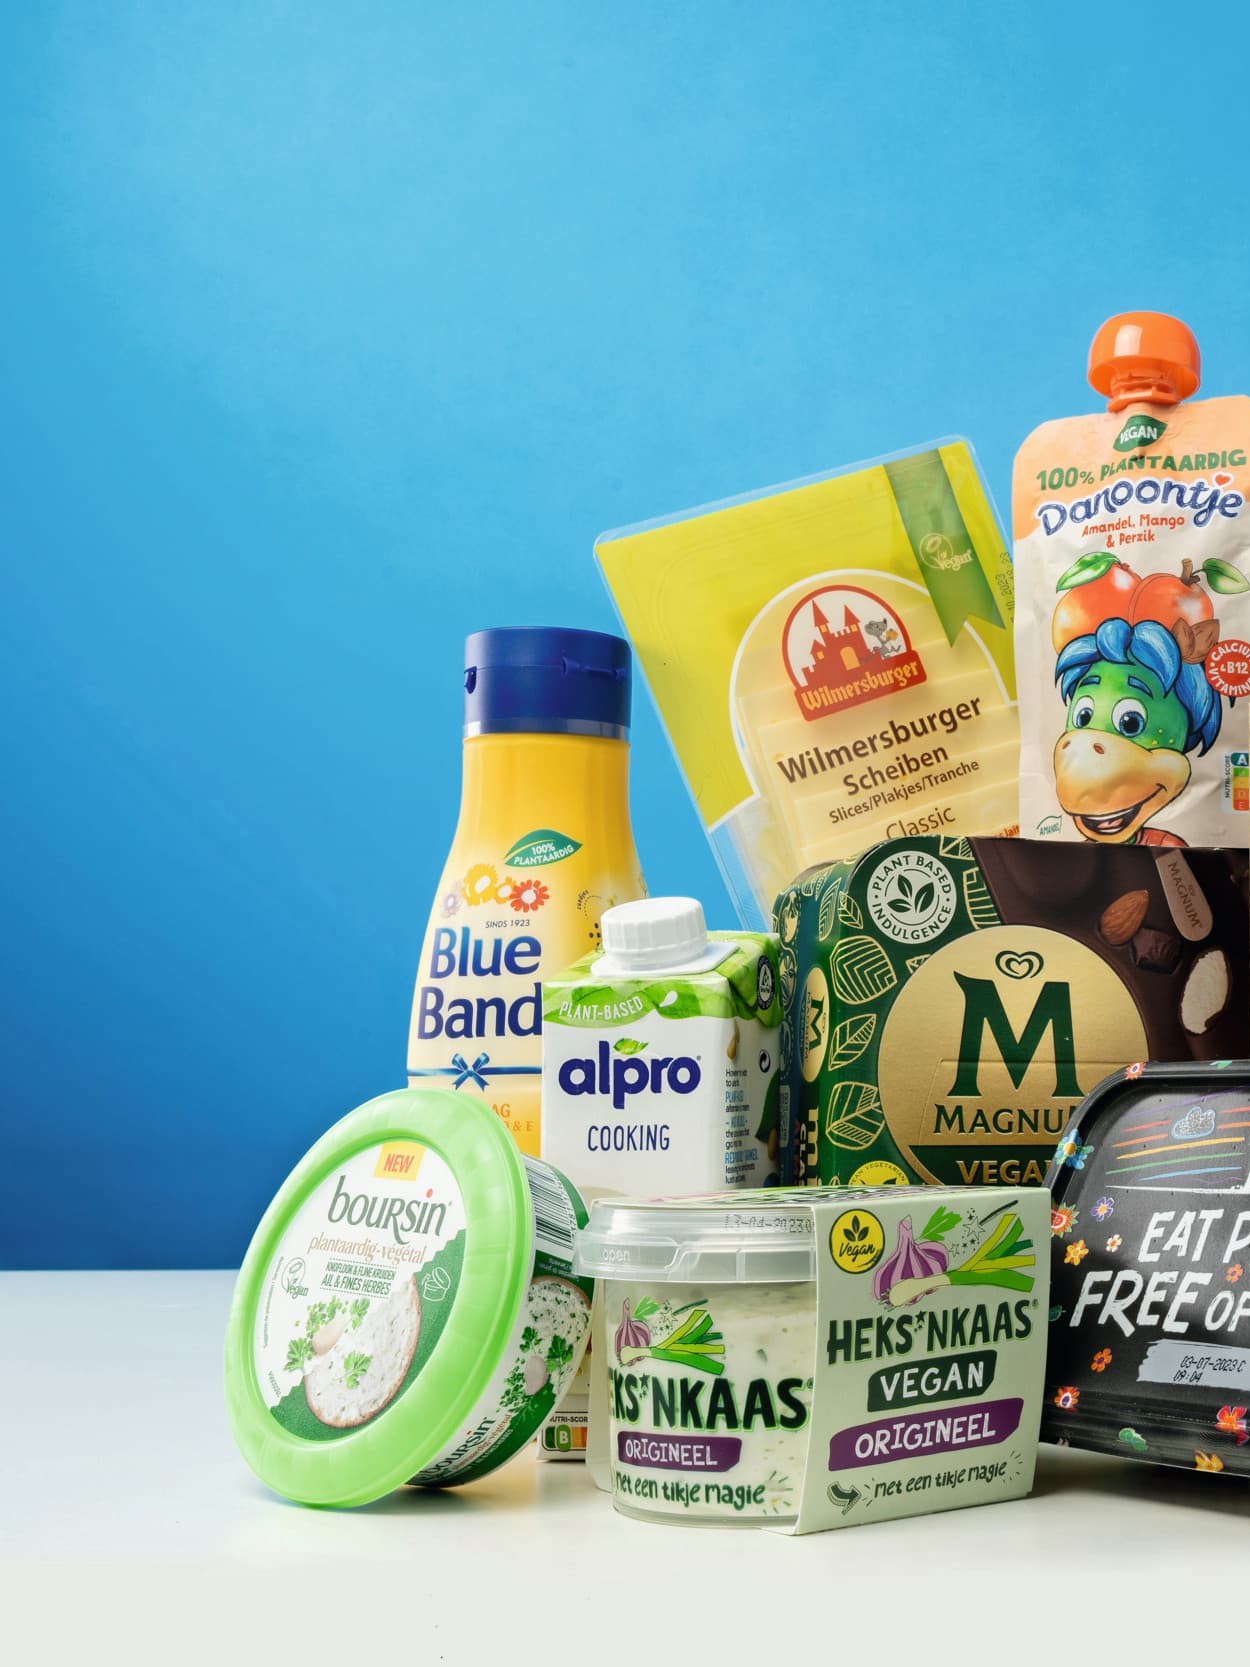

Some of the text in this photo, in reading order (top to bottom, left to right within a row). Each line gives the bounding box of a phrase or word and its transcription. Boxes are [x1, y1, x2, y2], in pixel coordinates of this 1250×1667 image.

[1036, 449, 1247, 490] 100% PLANTAARDIG
[1037, 474, 1243, 537] Danoontje
[1139, 514, 1185, 530] Mango
[1106, 532, 1155, 549] & Perzik
[800, 660, 919, 712] Wilmersburger
[1227, 662, 1249, 675] B12
[777, 697, 982, 785] Wilmersburger
[843, 746, 949, 797] Scheiben
[828, 760, 980, 824] Slices/Plakjes/Tranche
[885, 806, 956, 838] Classic
[513, 844, 574, 865] PLANTAARDIG
[531, 843, 556, 856] 100%
[872, 855, 952, 894] PLANT BASED
[1168, 861, 1203, 928] MAGNUM
[485, 919, 530, 929] SINDS 1923
[872, 902, 952, 940] INDULGENCE
[429, 926, 542, 979] Blue
[417, 982, 543, 1040] Band
[559, 996, 644, 1021] PLANT-BASED
[946, 970, 1087, 1098] M
[558, 1040, 702, 1110] alpro
[587, 1124, 671, 1151] COOKING
[383, 1153, 414, 1174] NEW
[956, 1159, 1052, 1185] VEGA
[328, 1175, 448, 1245] boursin
[839, 1241, 876, 1263] Vegan
[1138, 1208, 1224, 1263] EAT
[601, 1248, 631, 1264] open
[321, 1273, 392, 1296] AIL & FINES HERBES
[1069, 1269, 1213, 1337] FREE
[879, 1360, 985, 1402] VEGAN
[1180, 1355, 1236, 1371] 03-07-2023
[625, 1438, 718, 1466] ORIGINEEL
[854, 1413, 996, 1460] ORIGINEEL
[634, 1478, 658, 1498] een
[662, 1479, 700, 1508] tikje
[704, 1478, 766, 1511] magie
[874, 1461, 1007, 1498] met een tikje magie
